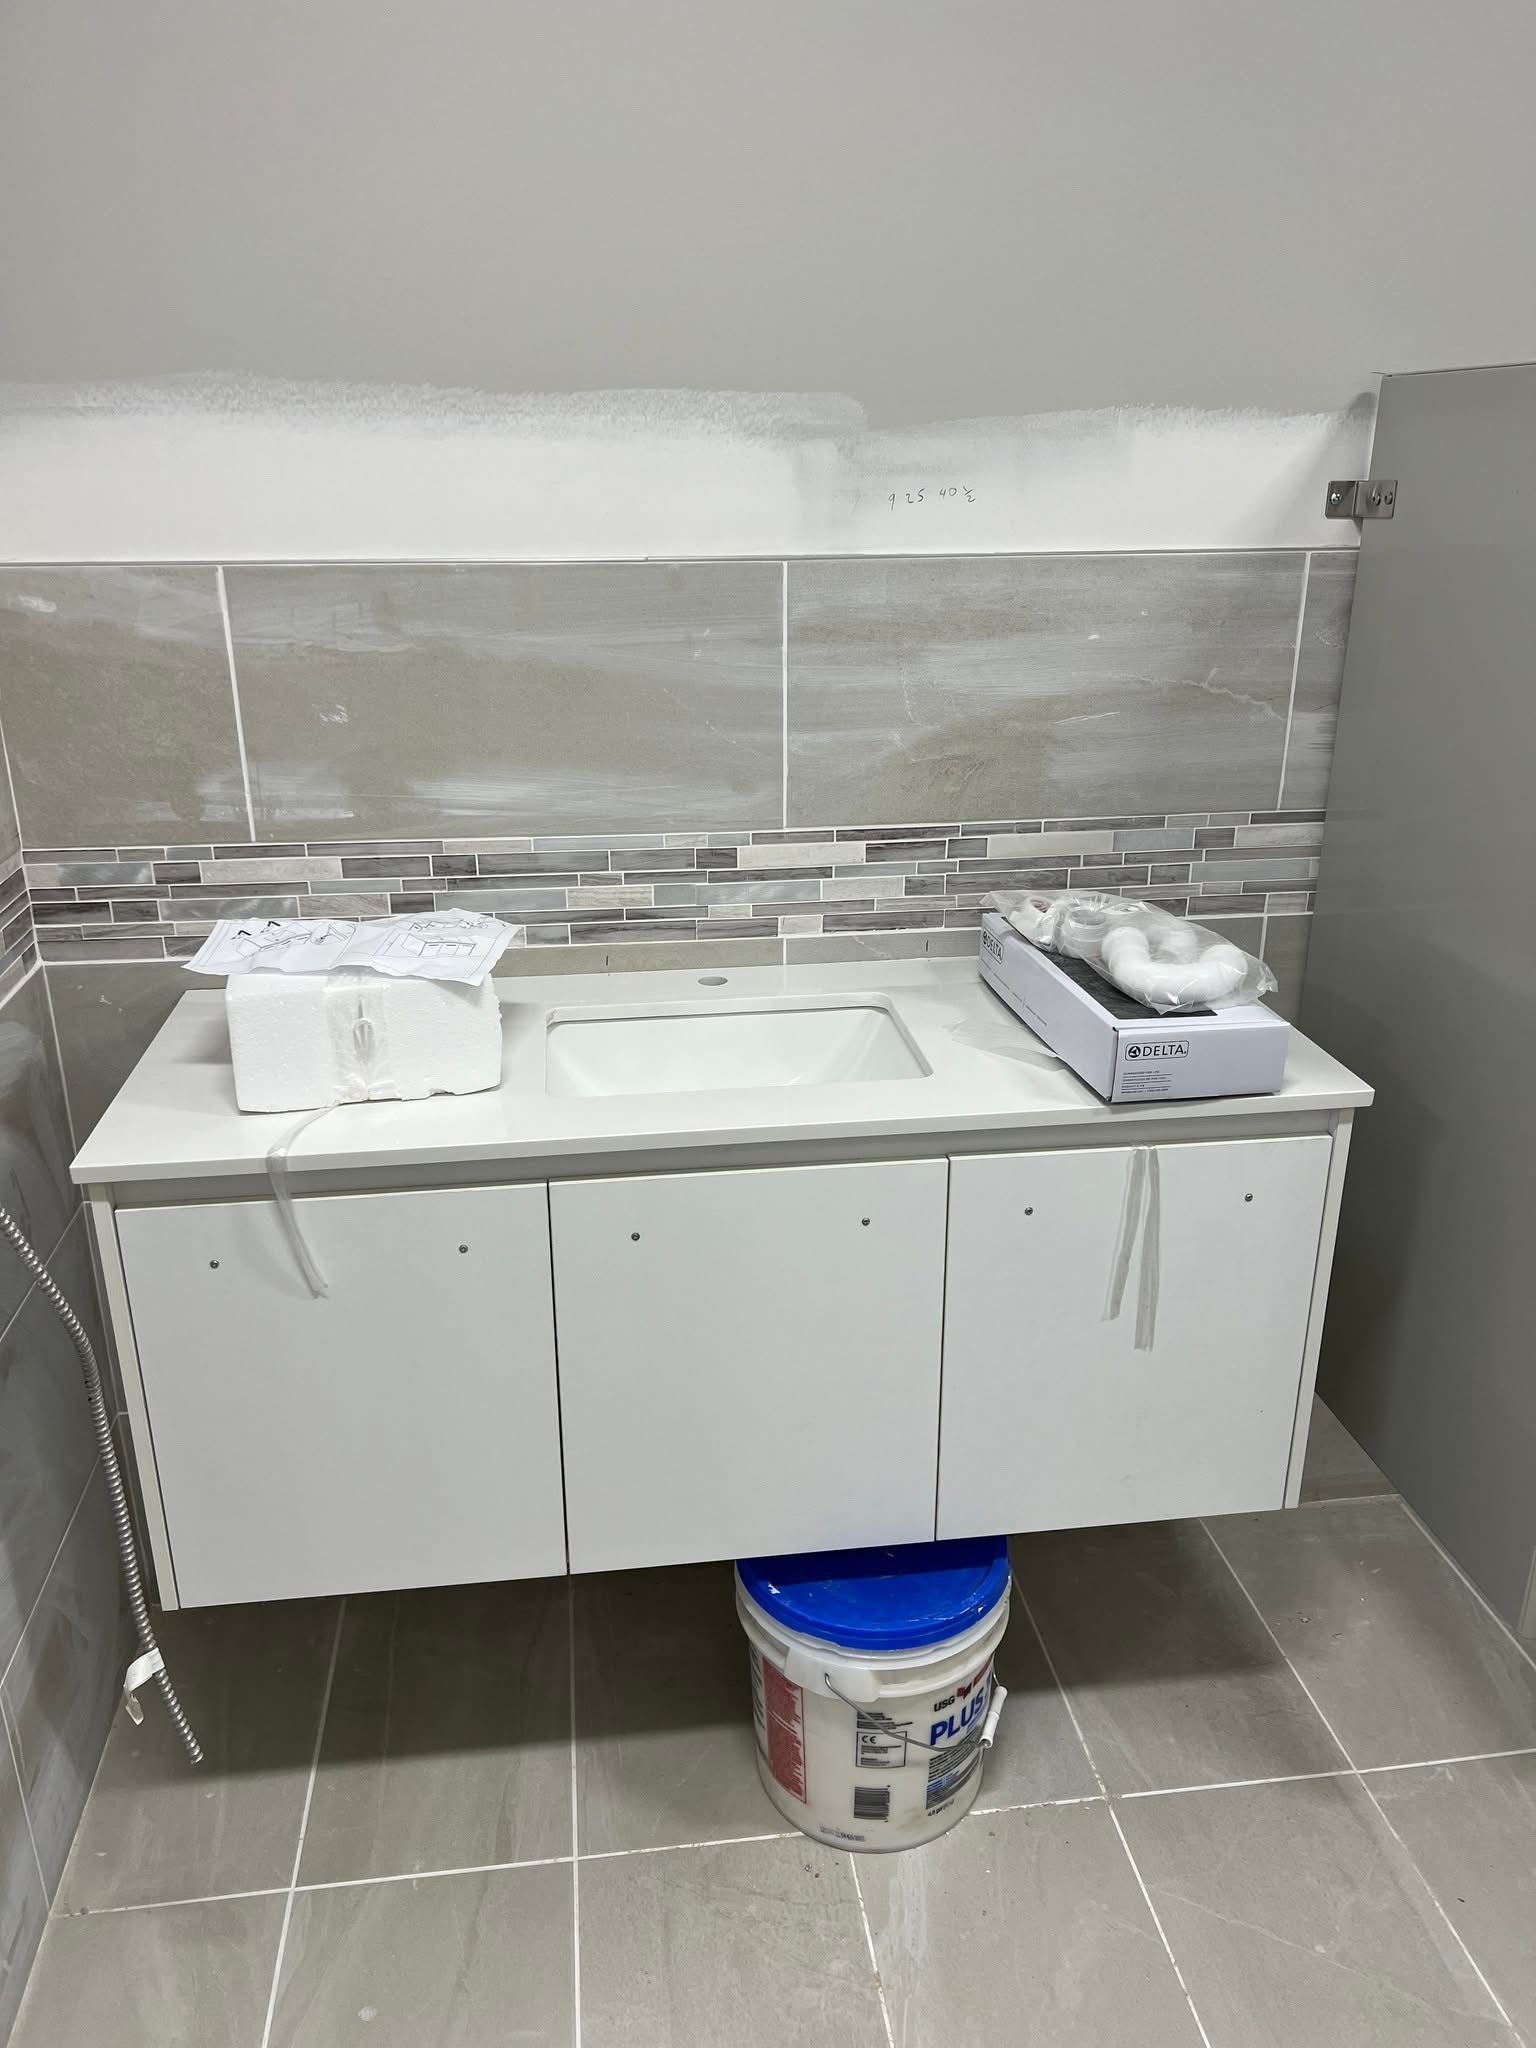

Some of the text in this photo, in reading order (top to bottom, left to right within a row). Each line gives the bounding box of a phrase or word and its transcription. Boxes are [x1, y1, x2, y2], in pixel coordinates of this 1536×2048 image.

[987, 935, 1002, 960] DELTA
[1142, 1044, 1184, 1057] DELTA
[933, 1696, 956, 1712] USG
[930, 1687, 985, 1746] PLUS
[861, 1735, 877, 1745] CE
